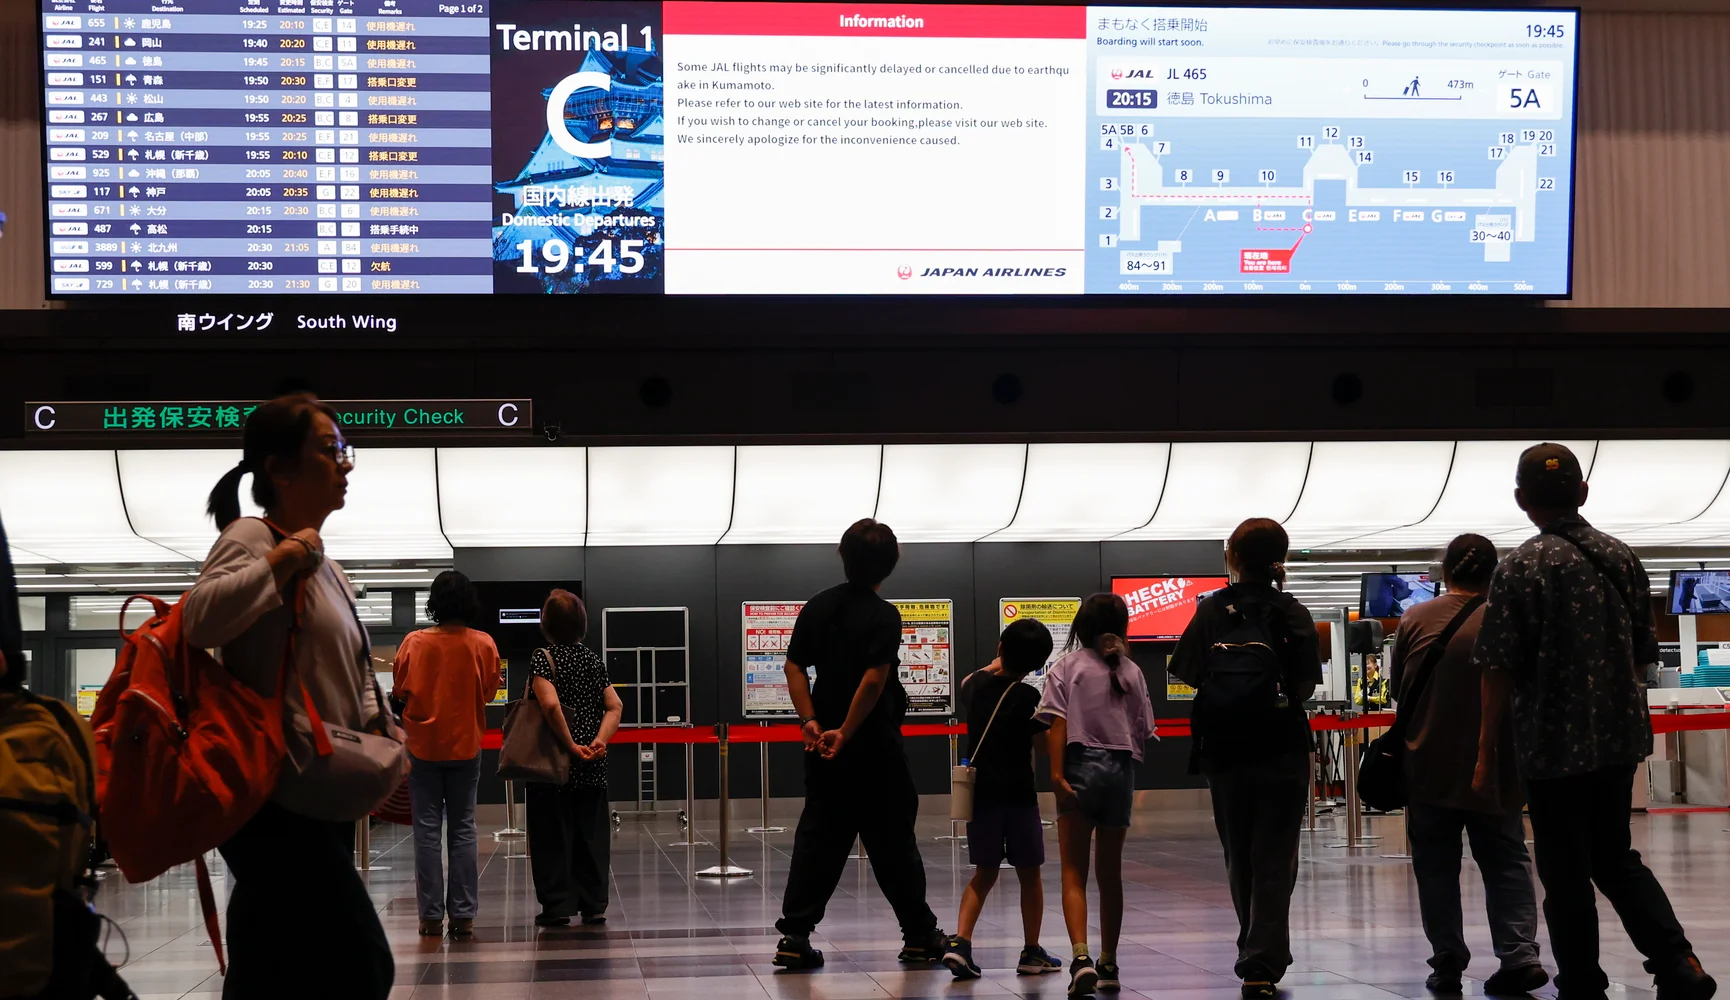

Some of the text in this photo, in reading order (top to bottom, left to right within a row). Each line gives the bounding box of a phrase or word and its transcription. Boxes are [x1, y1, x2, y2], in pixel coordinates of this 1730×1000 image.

[439, 4, 459, 14] Page
[467, 4, 476, 13] of
[478, 5, 483, 13] 2
[88, 19, 415, 31] 655 鹿児島 19:25 20:10 使用機遅れ
[840, 14, 923, 28] Information
[1098, 18, 1207, 31] まもなく搭乗開始
[1527, 25, 1564, 37] 19:45
[496, 24, 654, 51] Terminal 1
[1097, 37, 1137, 47] Boarding
[678, 62, 707, 71] Some
[711, 63, 729, 71] JAL
[733, 62, 766, 74] flights
[770, 65, 792, 74] may
[796, 63, 808, 72] be
[812, 63, 876, 75] significantly
[880, 64, 921, 75] delayed
[939, 65, 988, 74] cancelled
[992, 65, 1011, 74] due
[1015, 66, 1024, 74] to
[1028, 66, 1068, 76] earthqu
[1126, 69, 1206, 79] JAL JL 465
[1499, 70, 1550, 79] ゲート Gate
[91, 75, 416, 87] 151 青森 19:50 20:30 搭乗口変更
[678, 80, 774, 90] ake in Kumamoto.
[1363, 79, 1368, 87] 0
[1448, 80, 1473, 88] 473m
[678, 98, 712, 107] Please
[716, 98, 741, 107] refer
[779, 99, 801, 108] web
[804, 99, 823, 108] site
[826, 99, 841, 108] for
[844, 100, 861, 108] the
[865, 100, 893, 109] latest
[897, 100, 962, 109] information.
[1111, 92, 1151, 105] 20:15
[1167, 92, 1271, 105] 徳島 Tokushima
[1511, 89, 1540, 108] 5A
[546, 71, 612, 160] C
[1102, 125, 1116, 134] 5A
[1121, 125, 1133, 135] 5B
[1326, 128, 1337, 137] 12
[92, 131, 108, 139] 209
[246, 132, 269, 140] 19:55
[369, 133, 417, 142] 使用機遅れ
[678, 134, 959, 146] We sincerely apologize for the inconvenience caused.
[1503, 134, 1513, 143] 18
[1540, 131, 1552, 140] 20
[1106, 139, 1112, 148] 4
[1301, 137, 1311, 146] 11
[1351, 137, 1362, 147] 13
[1159, 143, 1164, 152] 7
[1491, 148, 1502, 157] 17
[93, 169, 109, 177] 925
[370, 170, 418, 180] 使用機遅れ
[1181, 171, 1187, 180] 8
[1263, 171, 1274, 180] 10
[1407, 172, 1417, 181] 15
[1540, 179, 1552, 188] 22
[522, 184, 635, 209] 国内線出発
[1105, 208, 1111, 217] 2
[1253, 209, 1262, 222] B
[1349, 210, 1357, 222] E
[1431, 210, 1442, 222] G
[502, 212, 656, 230] Domestic Departures
[515, 239, 645, 274] 19:45
[96, 262, 112, 270] 599
[248, 262, 272, 270] 20:30
[371, 262, 390, 271] 欠航
[921, 268, 1066, 276] JAPAN AIRLINES
[1513, 283, 1534, 291] 500m
[178, 312, 396, 332] 南ウイング South Wing
[35, 406, 55, 429] C
[103, 405, 258, 430] 出発保安検
[404, 409, 463, 424] Check
[499, 403, 518, 426] C
[1122, 578, 1178, 607] HECK
[1128, 589, 1184, 617] BATTERY
